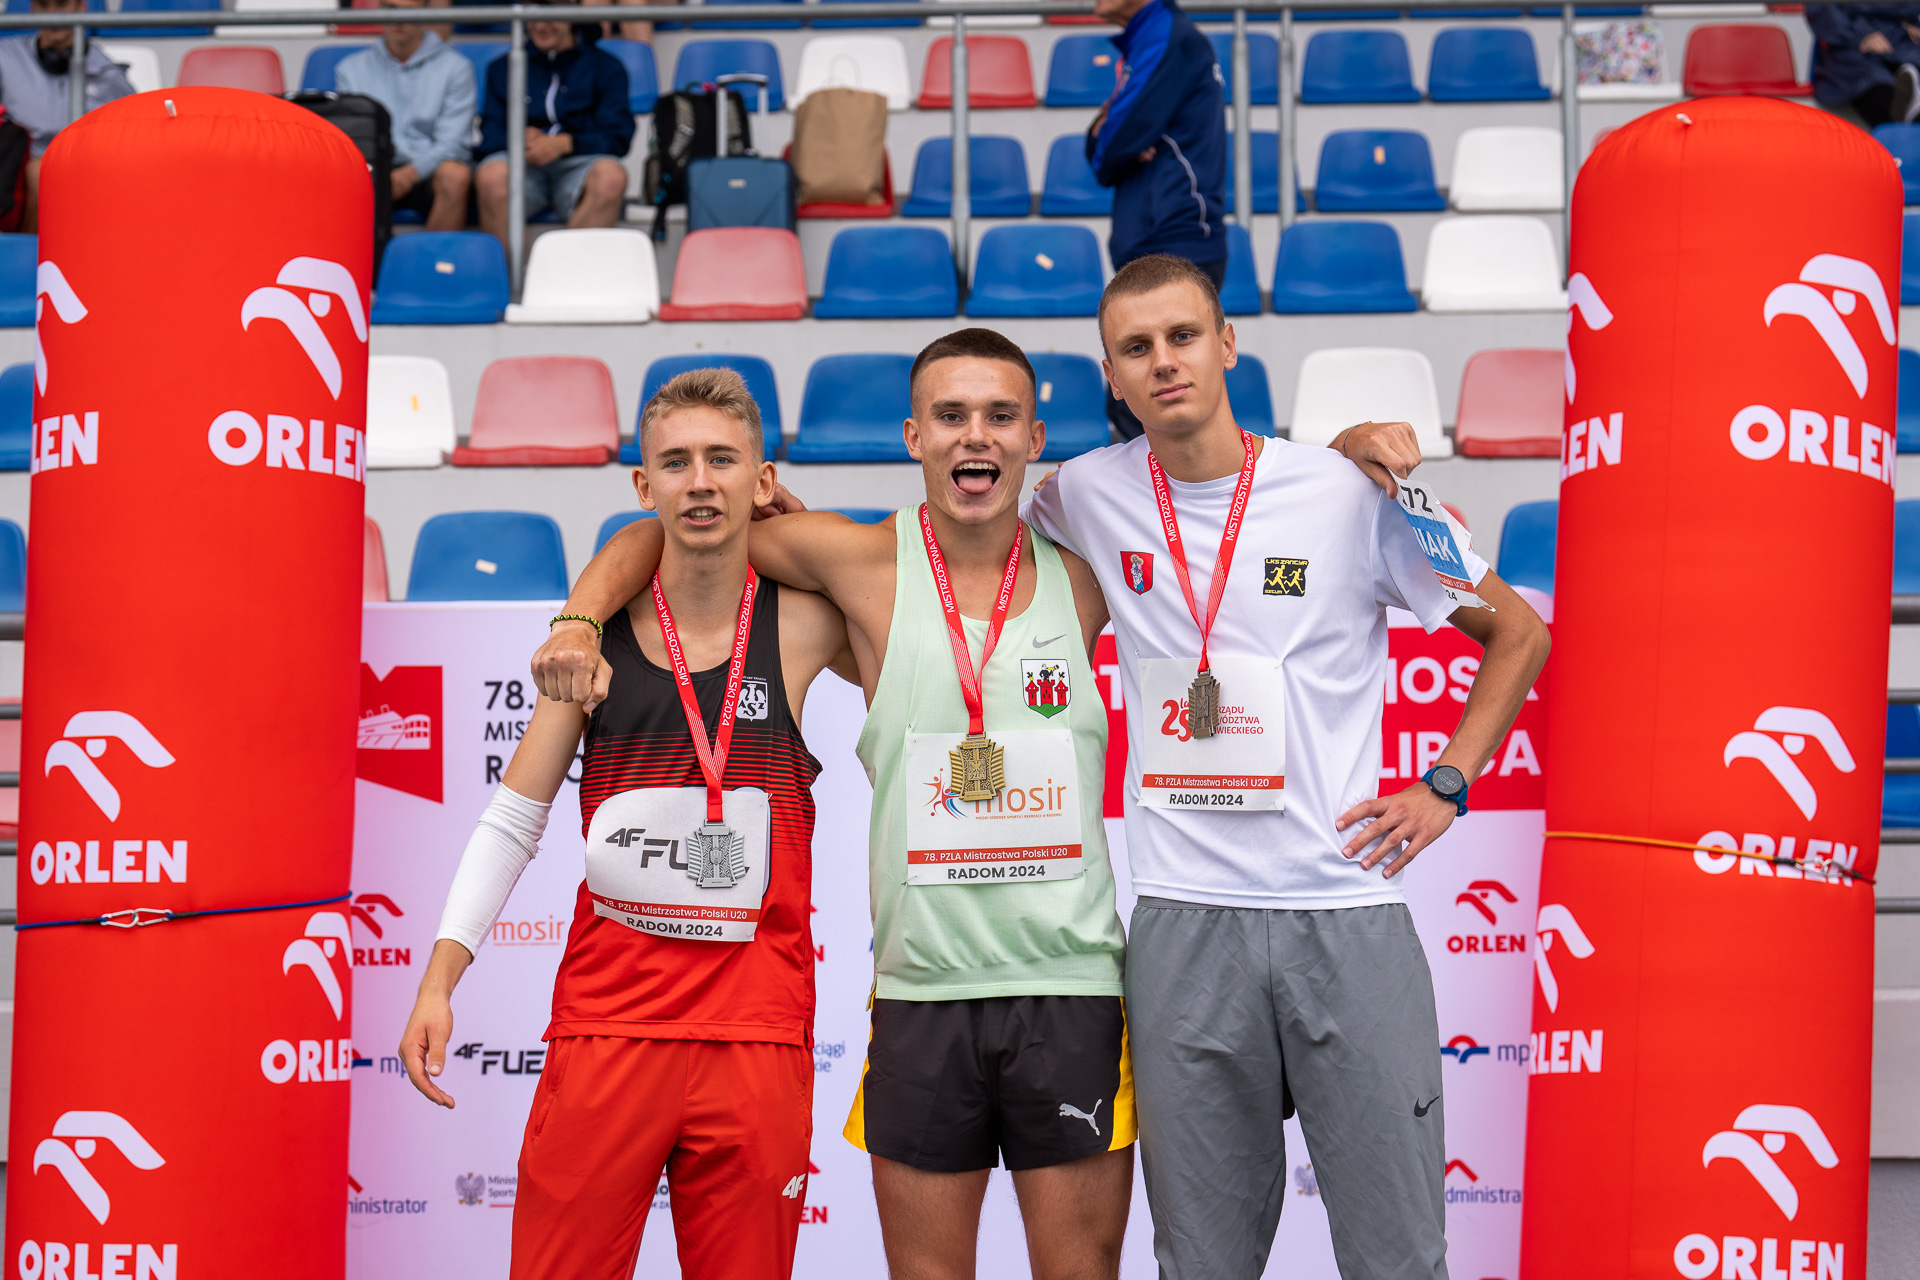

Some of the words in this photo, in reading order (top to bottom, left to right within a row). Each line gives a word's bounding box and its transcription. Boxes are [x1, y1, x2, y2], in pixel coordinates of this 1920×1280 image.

[1153, 470, 1177, 542] MISTRZOSTWA
[1226, 471, 1251, 541] MISTRZOSTWA
[1400, 485, 1433, 513] 72
[929, 543, 955, 613] MISTRZOSTWA
[998, 546, 1020, 612] MISTRZOSTWA
[733, 583, 753, 659] MISTRZOSTWA
[661, 610, 690, 685] MISTRZOSTWA
[727, 660, 743, 698] POLSKI
[484, 680, 534, 710] 78.
[722, 700, 734, 726] 2024
[484, 721, 531, 741] MIS
[1379, 730, 1542, 779] LIPA
[1155, 777, 1165, 786] 78.
[1166, 777, 1182, 786] PZLA
[1182, 778, 1221, 788] Mistrzostwa
[1222, 778, 1248, 787] Polski
[1250, 778, 1270, 787] U20
[1169, 794, 1209, 805] RADOM
[1211, 794, 1244, 806] 2024
[605, 828, 646, 847] 4F
[30, 840, 188, 885] ORLEN
[924, 853, 938, 862] 78.
[940, 852, 962, 861] PZLA
[963, 850, 1020, 860] Mistrzostwa
[1022, 848, 1049, 858] Polski
[1051, 848, 1068, 857] U20
[1693, 830, 1858, 887] ORLEN
[947, 867, 1005, 879] RADOM
[1008, 865, 1045, 877] 2024
[604, 898, 617, 908] 78.
[618, 902, 639, 913] PZLA
[641, 905, 698, 918] Mistrzostwa
[700, 909, 728, 919] Polski
[730, 910, 748, 920] U20
[493, 914, 565, 940] mosir
[626, 916, 682, 935] RADOM
[686, 924, 723, 937] 2024
[1447, 934, 1526, 954] ORLEN
[453, 1043, 483, 1059] 4F
[782, 1173, 806, 1199] 4F
[18, 1239, 178, 1280] ORLEN
[1673, 1233, 1844, 1280] ORLEN
